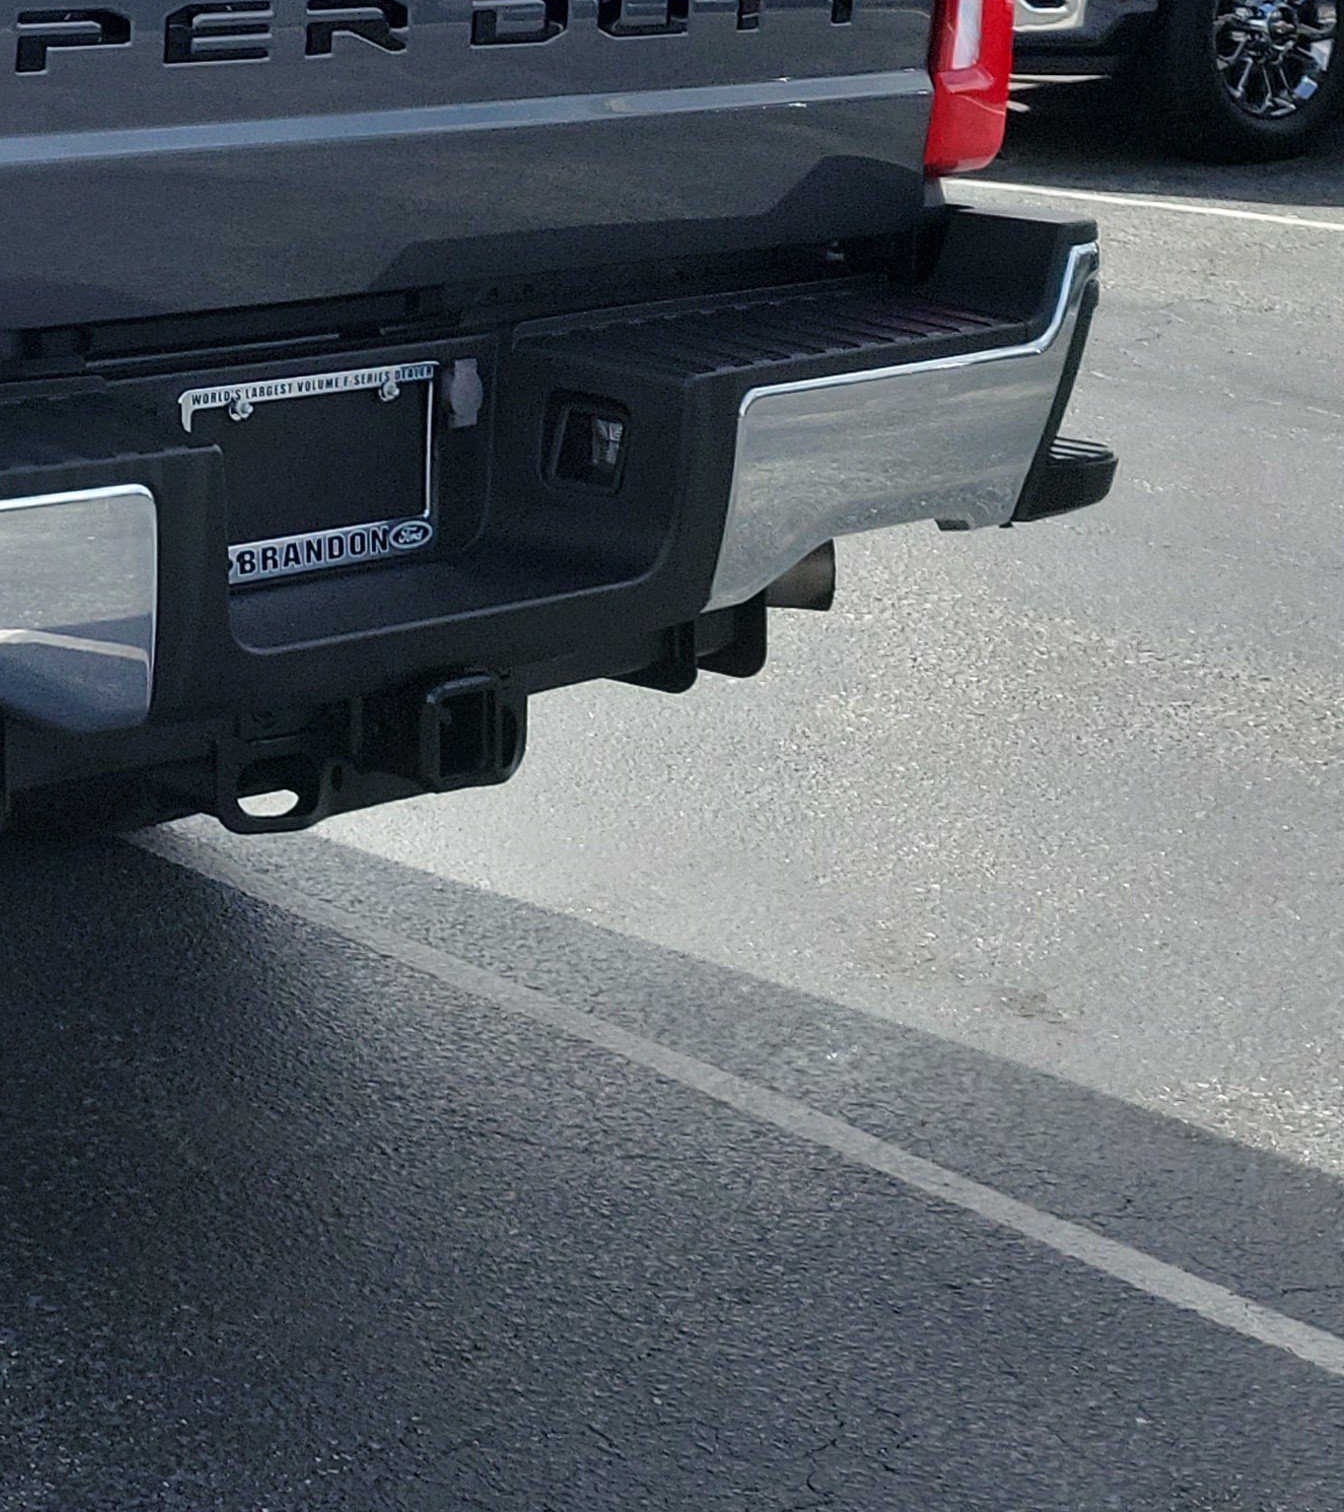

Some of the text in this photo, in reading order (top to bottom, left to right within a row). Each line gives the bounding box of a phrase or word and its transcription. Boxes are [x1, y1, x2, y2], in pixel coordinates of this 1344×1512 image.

[191, 389, 242, 406] WORLD'S
[245, 382, 293, 400] LARGEST
[297, 377, 340, 392] VOLUME
[343, 370, 391, 387] F-SERIES
[236, 525, 424, 576] BRANDON Ford
